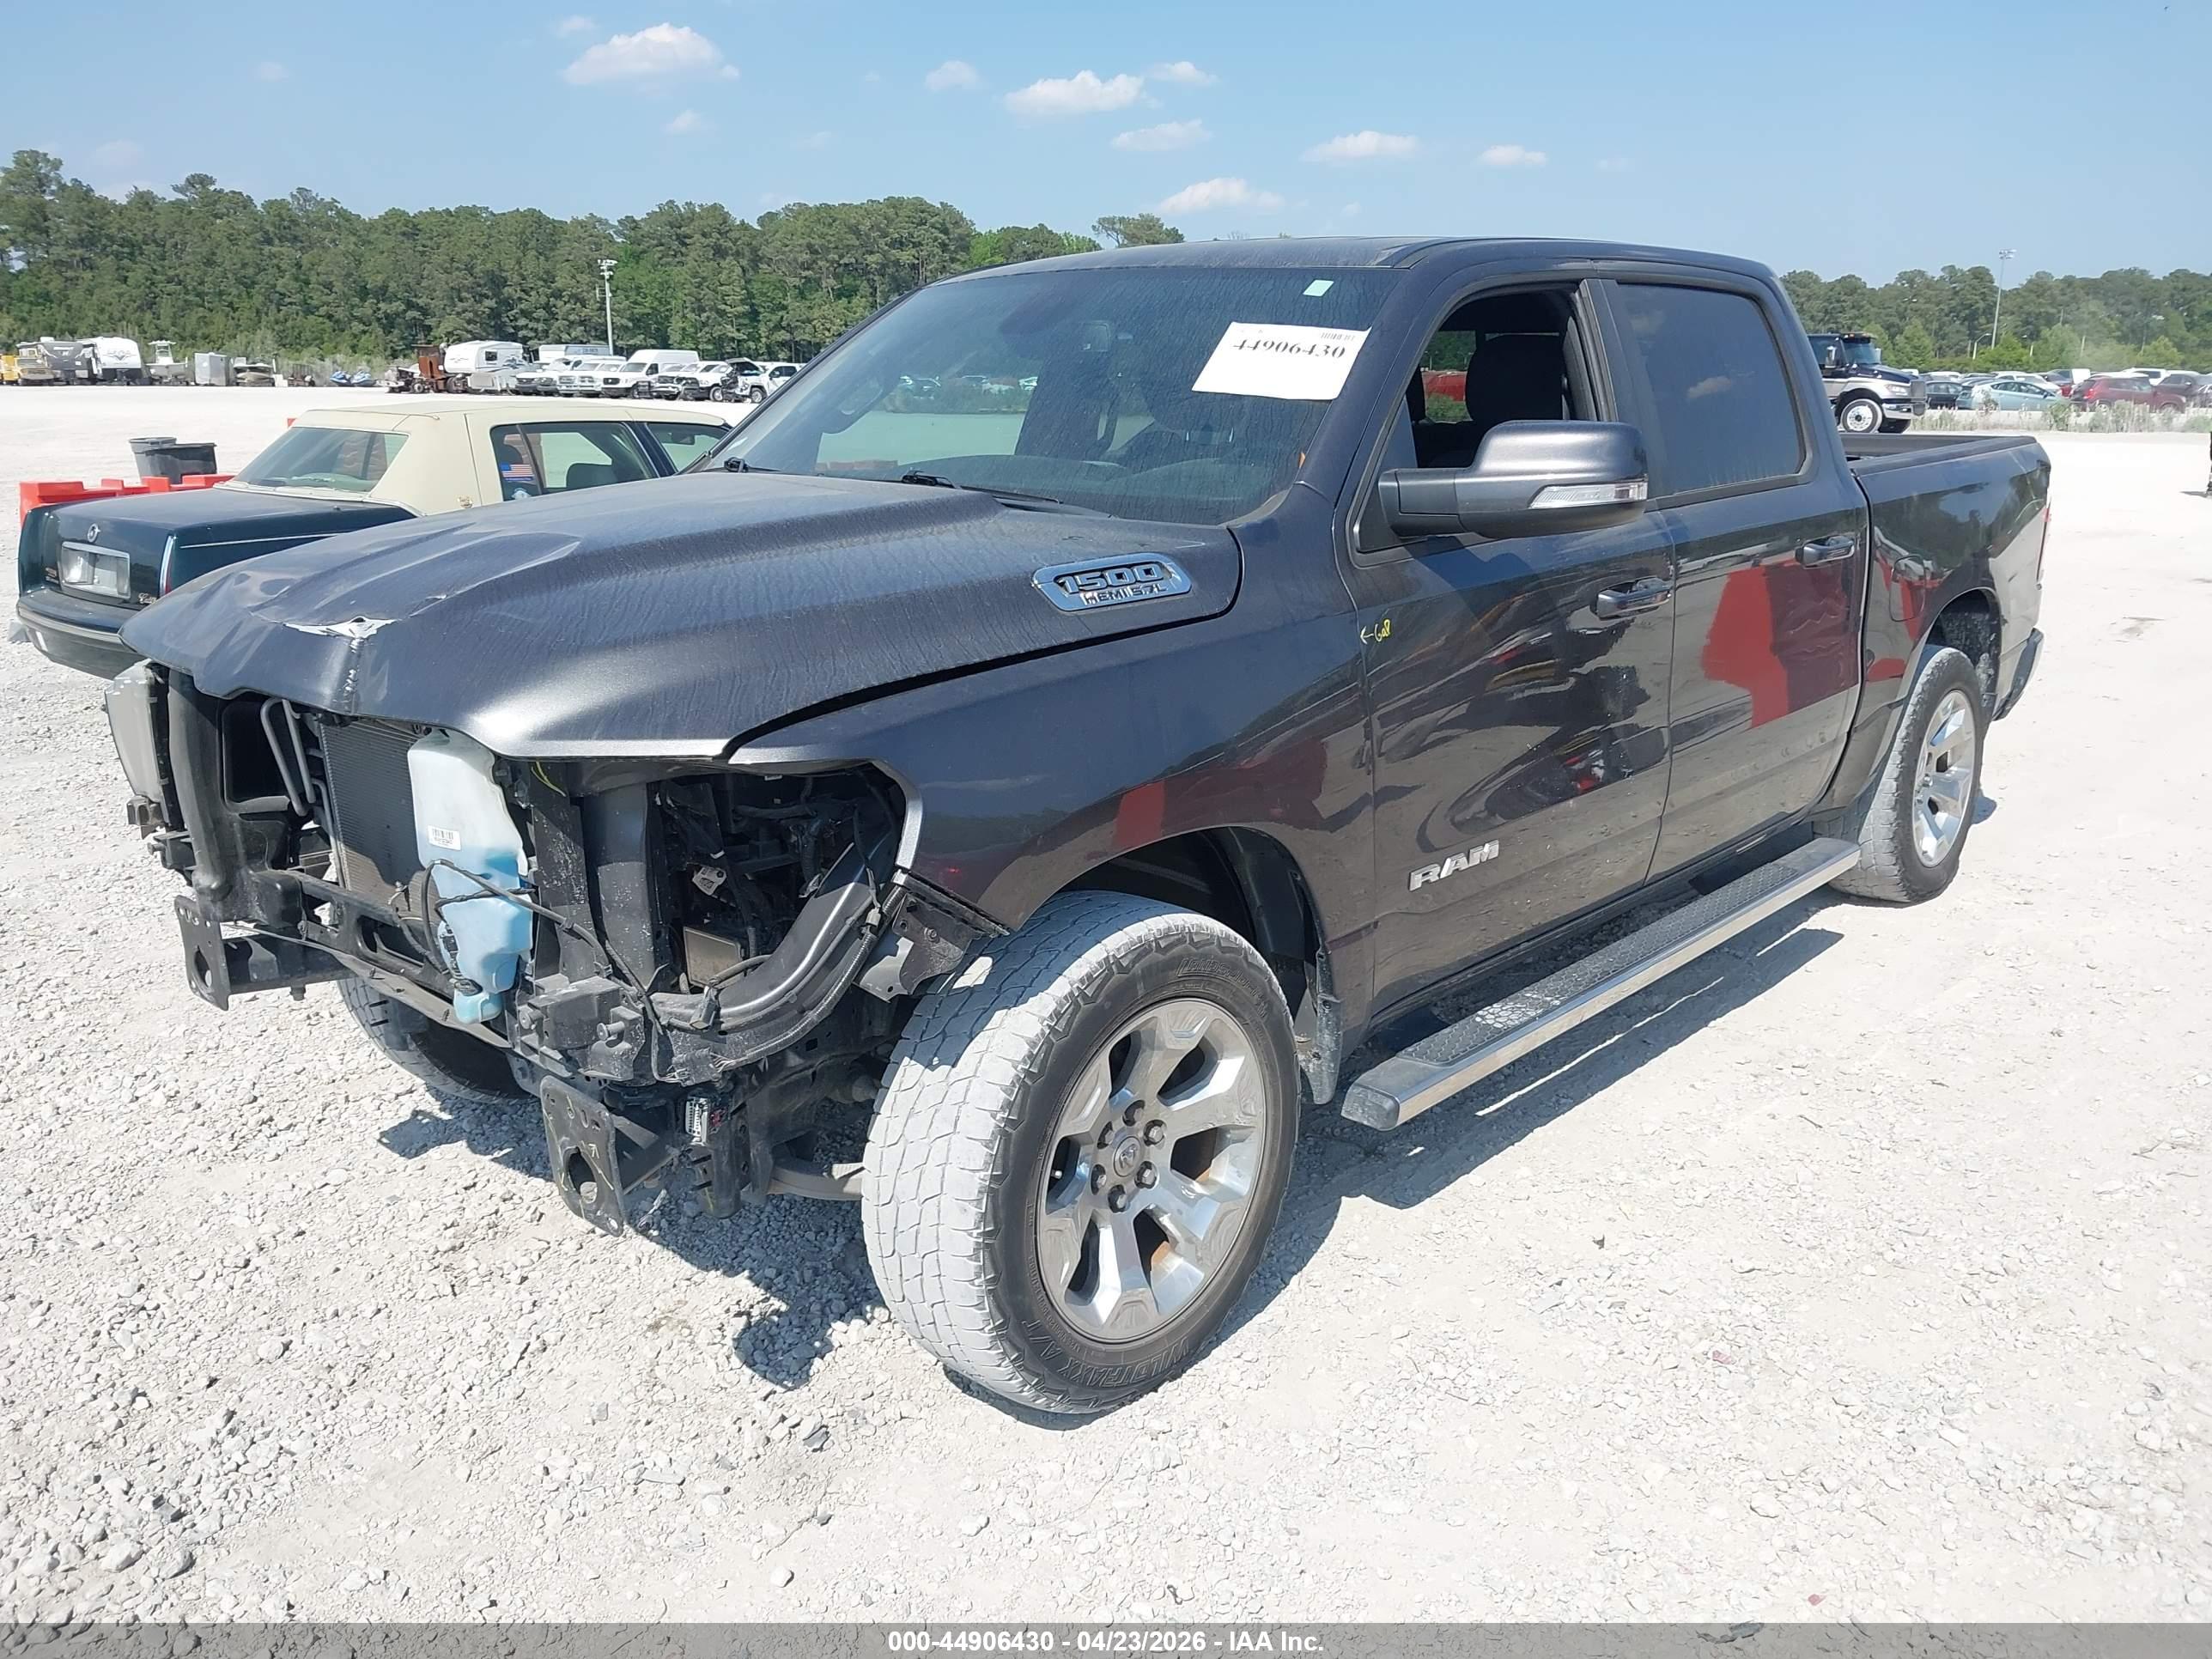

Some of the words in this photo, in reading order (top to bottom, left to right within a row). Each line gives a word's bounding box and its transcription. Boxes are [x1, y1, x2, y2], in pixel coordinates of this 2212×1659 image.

[1233, 338, 1346, 358] 44906430
[1058, 563, 1164, 594] 1500
[1409, 839, 1499, 891] RAM
